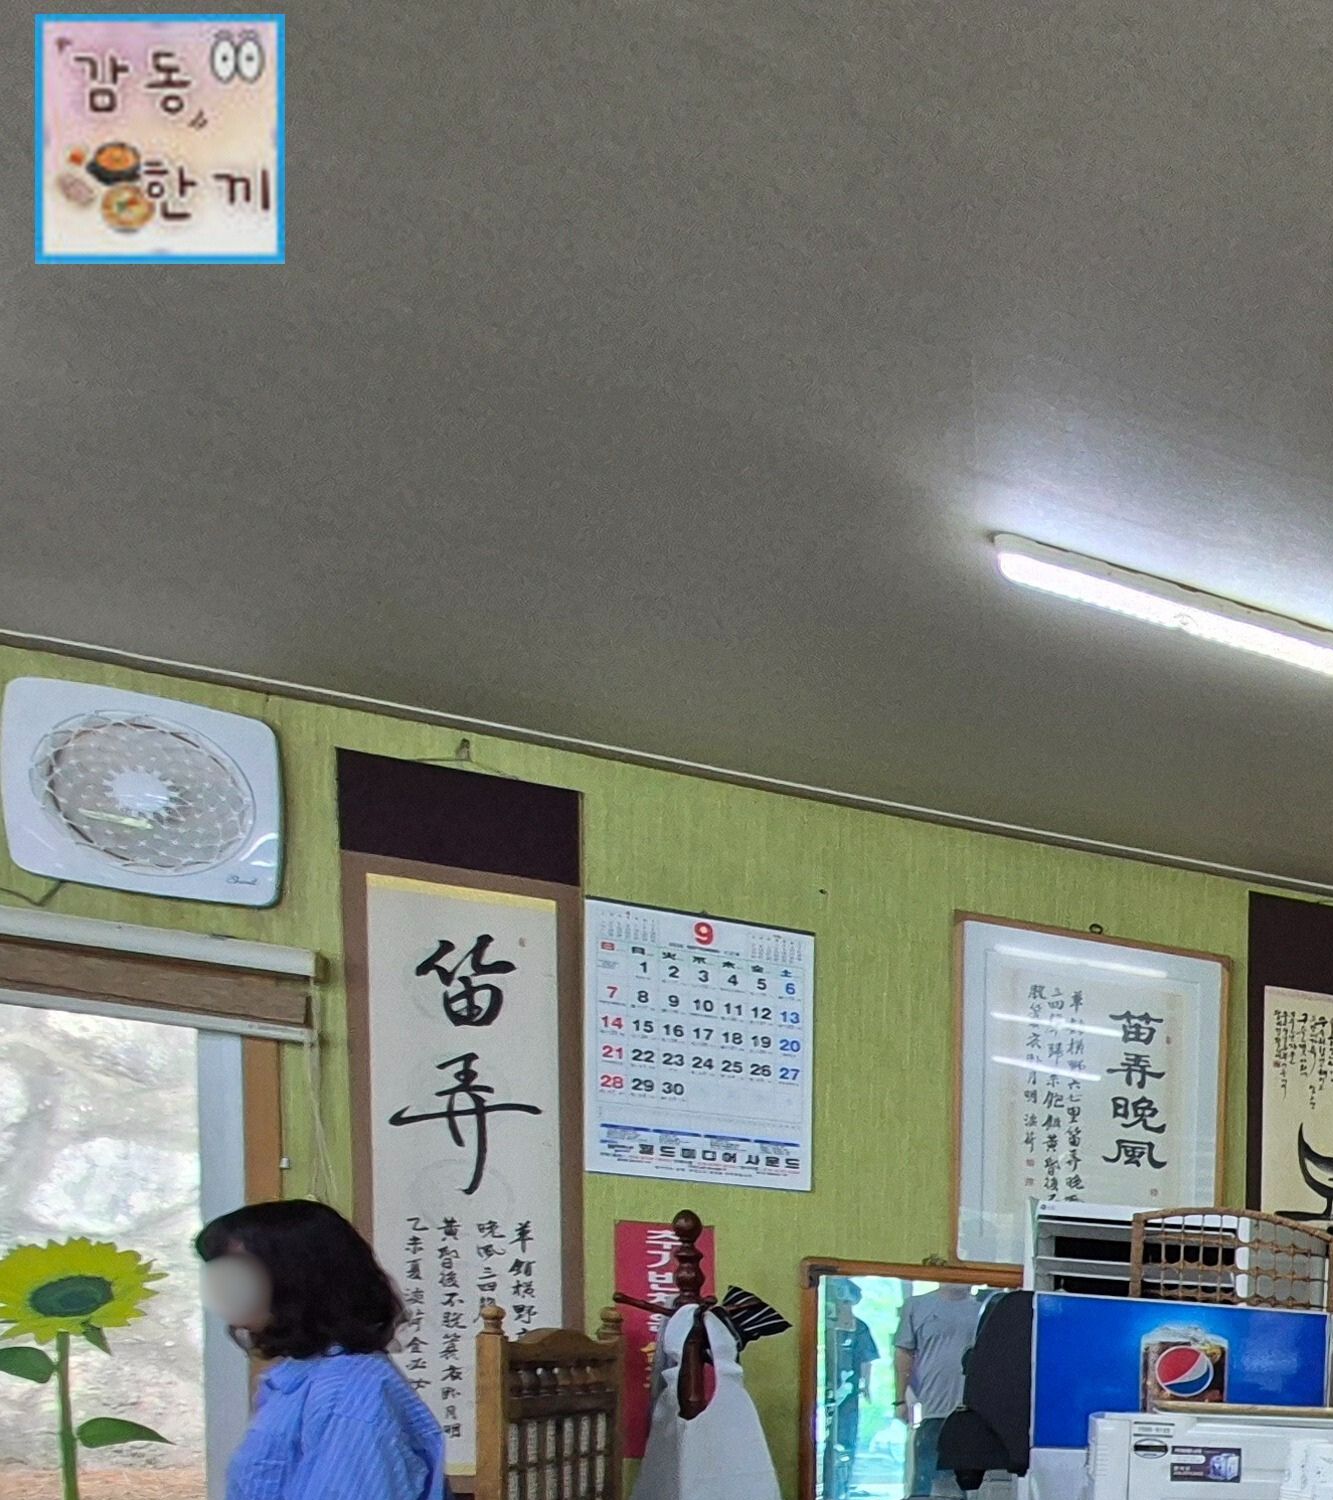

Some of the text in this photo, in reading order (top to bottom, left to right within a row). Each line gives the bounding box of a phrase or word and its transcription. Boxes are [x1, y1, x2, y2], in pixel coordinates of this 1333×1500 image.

[694, 921, 714, 945] 9
[640, 962, 796, 995] 1 2 3 4 5 6
[607, 986, 800, 1024] 7 8 9 10 11 12 13
[601, 1016, 801, 1052] 14 15 16 17 18 19 20
[602, 1045, 800, 1080] 21 22 23 24 25 26 27
[600, 1074, 684, 1096] 28 29 30
